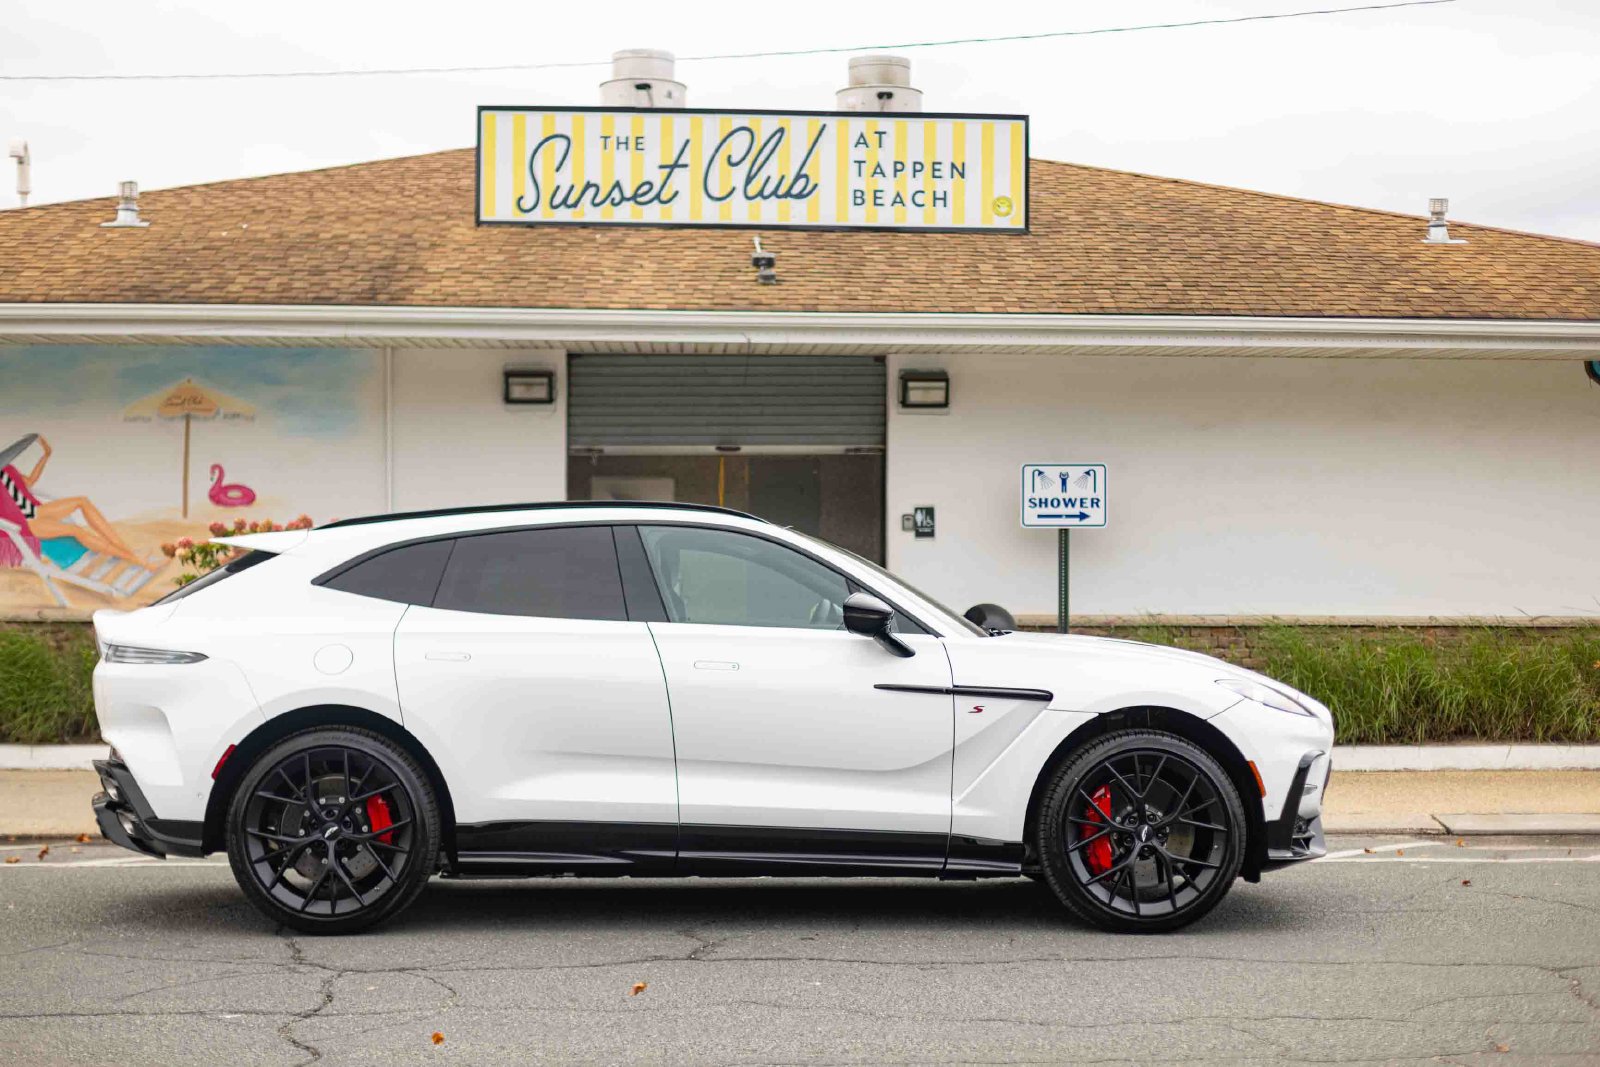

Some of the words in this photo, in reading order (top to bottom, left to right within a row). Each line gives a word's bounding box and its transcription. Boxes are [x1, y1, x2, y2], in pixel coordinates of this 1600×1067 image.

[600, 136, 646, 151] THE
[854, 130, 887, 149] AT
[516, 133, 690, 214] Sunset
[703, 123, 827, 201] Club
[853, 160, 966, 180] TAPPEN
[853, 189, 948, 208] BEACH
[1028, 497, 1101, 509] SHOWER
